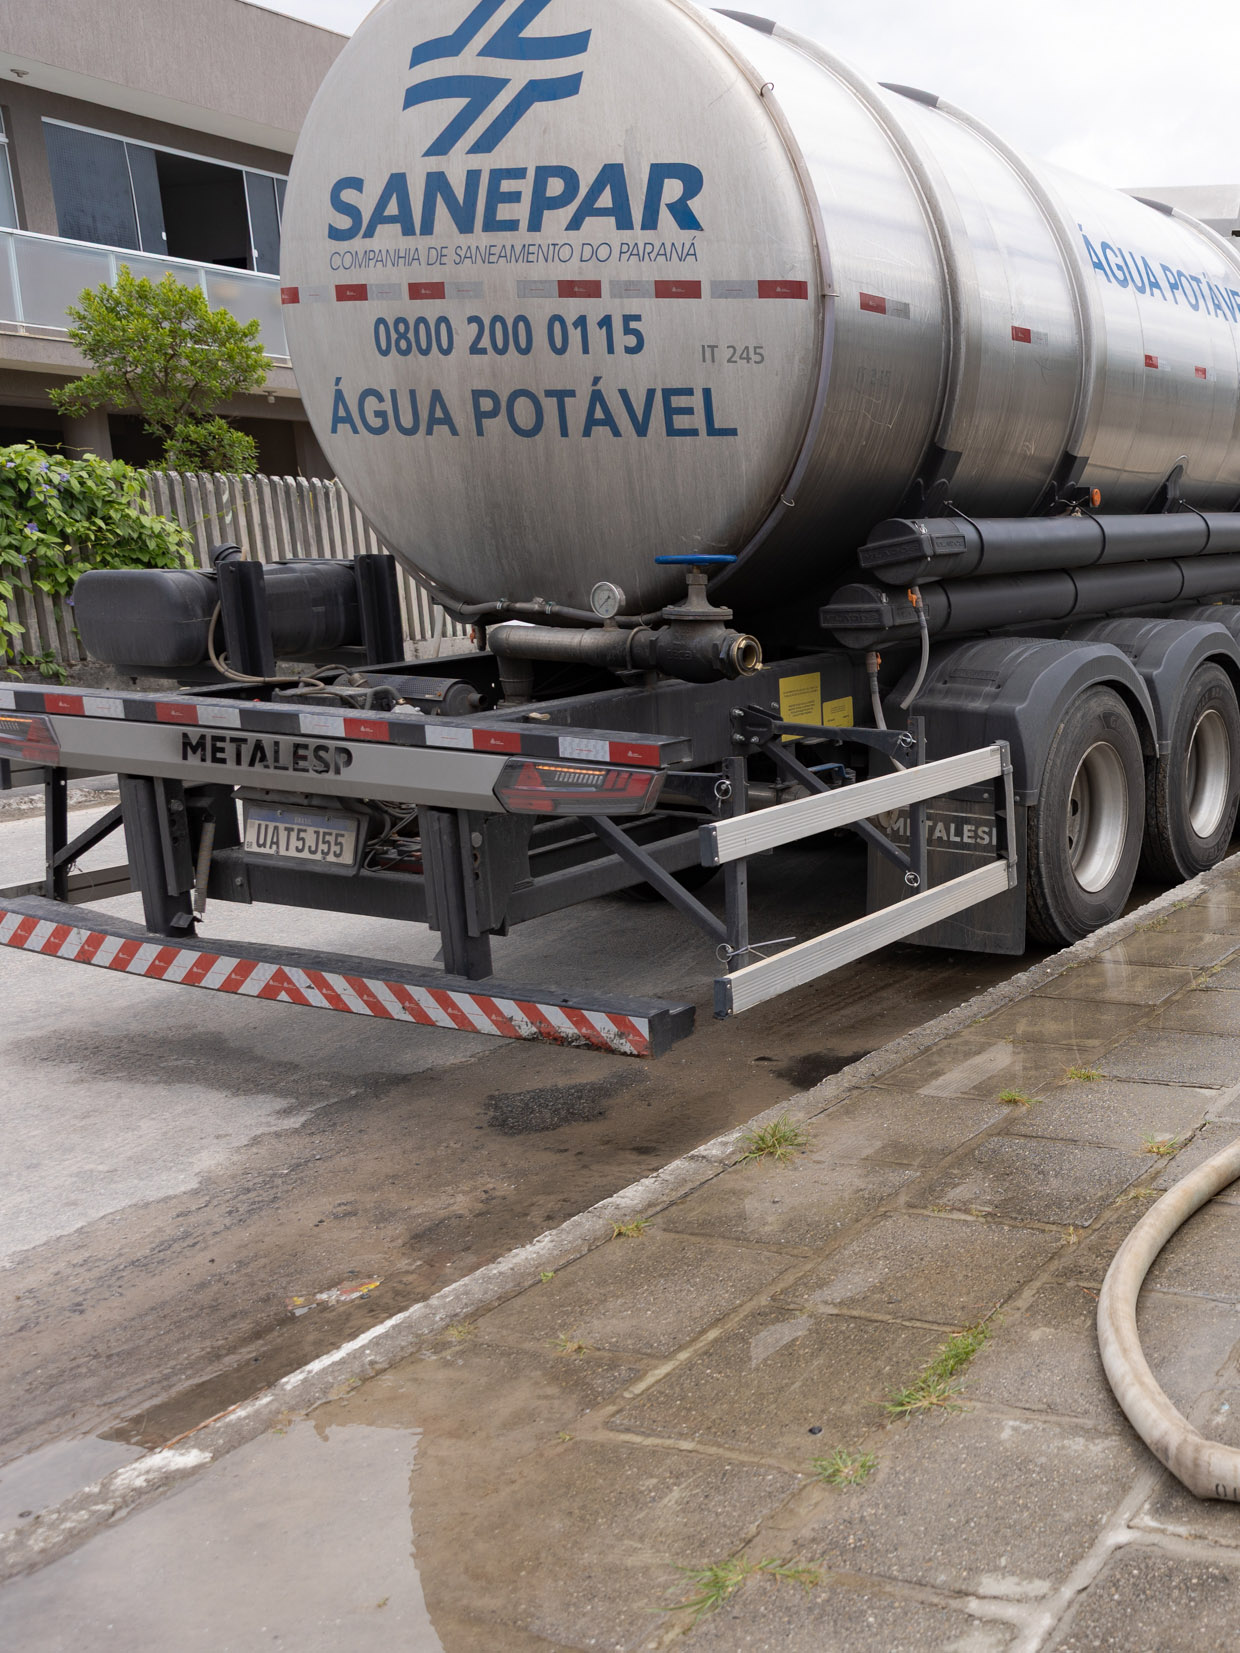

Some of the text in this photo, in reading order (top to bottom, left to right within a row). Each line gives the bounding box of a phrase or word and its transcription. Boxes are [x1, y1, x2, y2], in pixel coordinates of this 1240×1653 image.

[327, 162, 704, 242] SANEPAR
[329, 235, 699, 271] COMPANHIA DE SANEAMENTO DO PARANÁ
[1078, 223, 1167, 302] ÁGUA
[373, 312, 645, 357] 0800 200 0115
[701, 344, 765, 365] IT 245
[330, 375, 739, 439] ÁGUA POTÁVEL
[181, 732, 353, 776] METALESP
[255, 822, 345, 859] UAT5J55
[886, 817, 997, 846] MTALES
